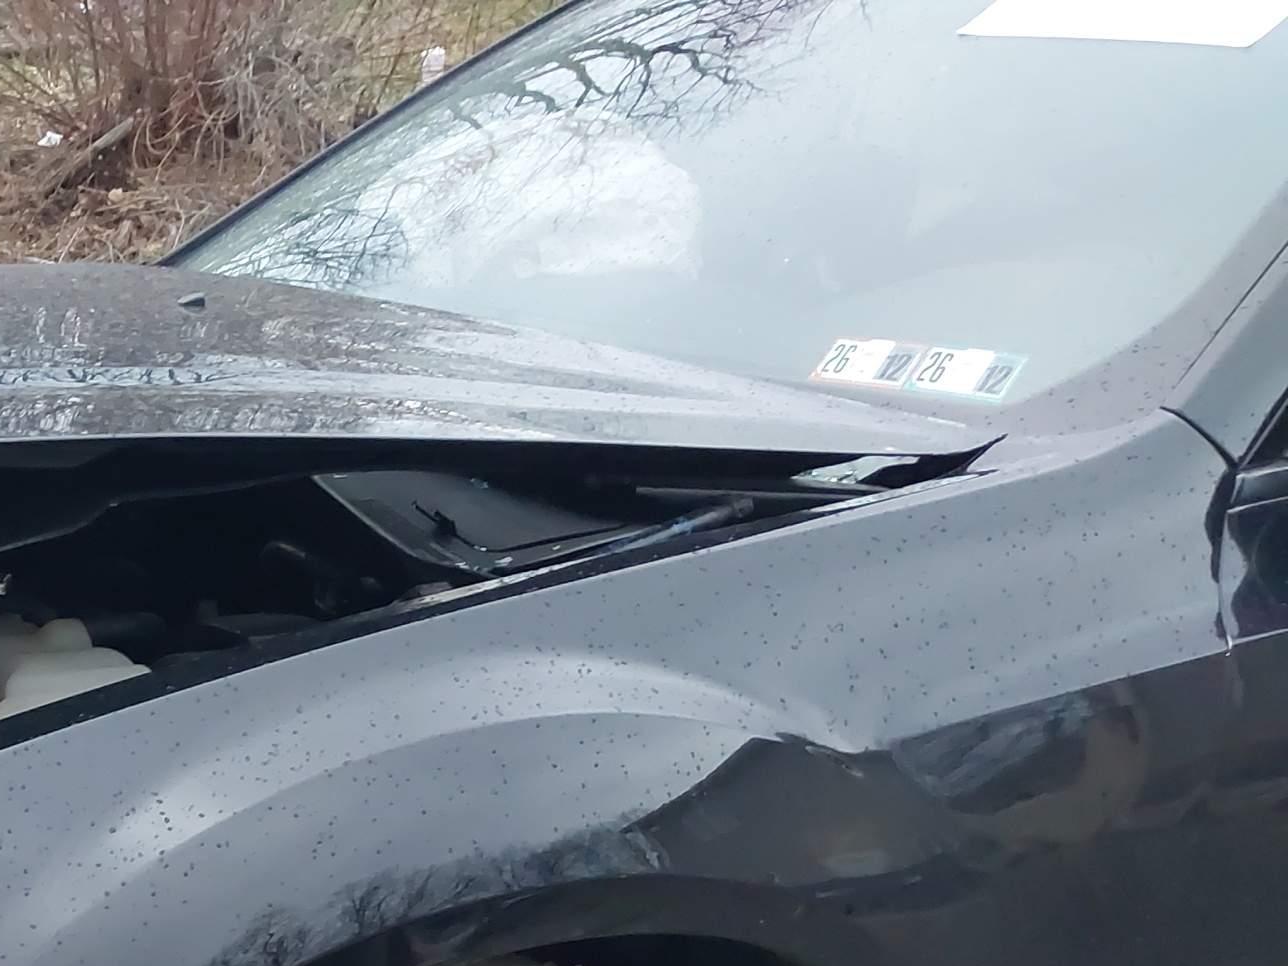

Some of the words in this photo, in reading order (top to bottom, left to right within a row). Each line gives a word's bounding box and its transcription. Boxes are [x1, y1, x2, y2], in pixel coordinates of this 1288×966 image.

[821, 343, 857, 374] 26
[878, 353, 913, 382] 12
[916, 351, 954, 383] 26
[976, 364, 1014, 395] 12
